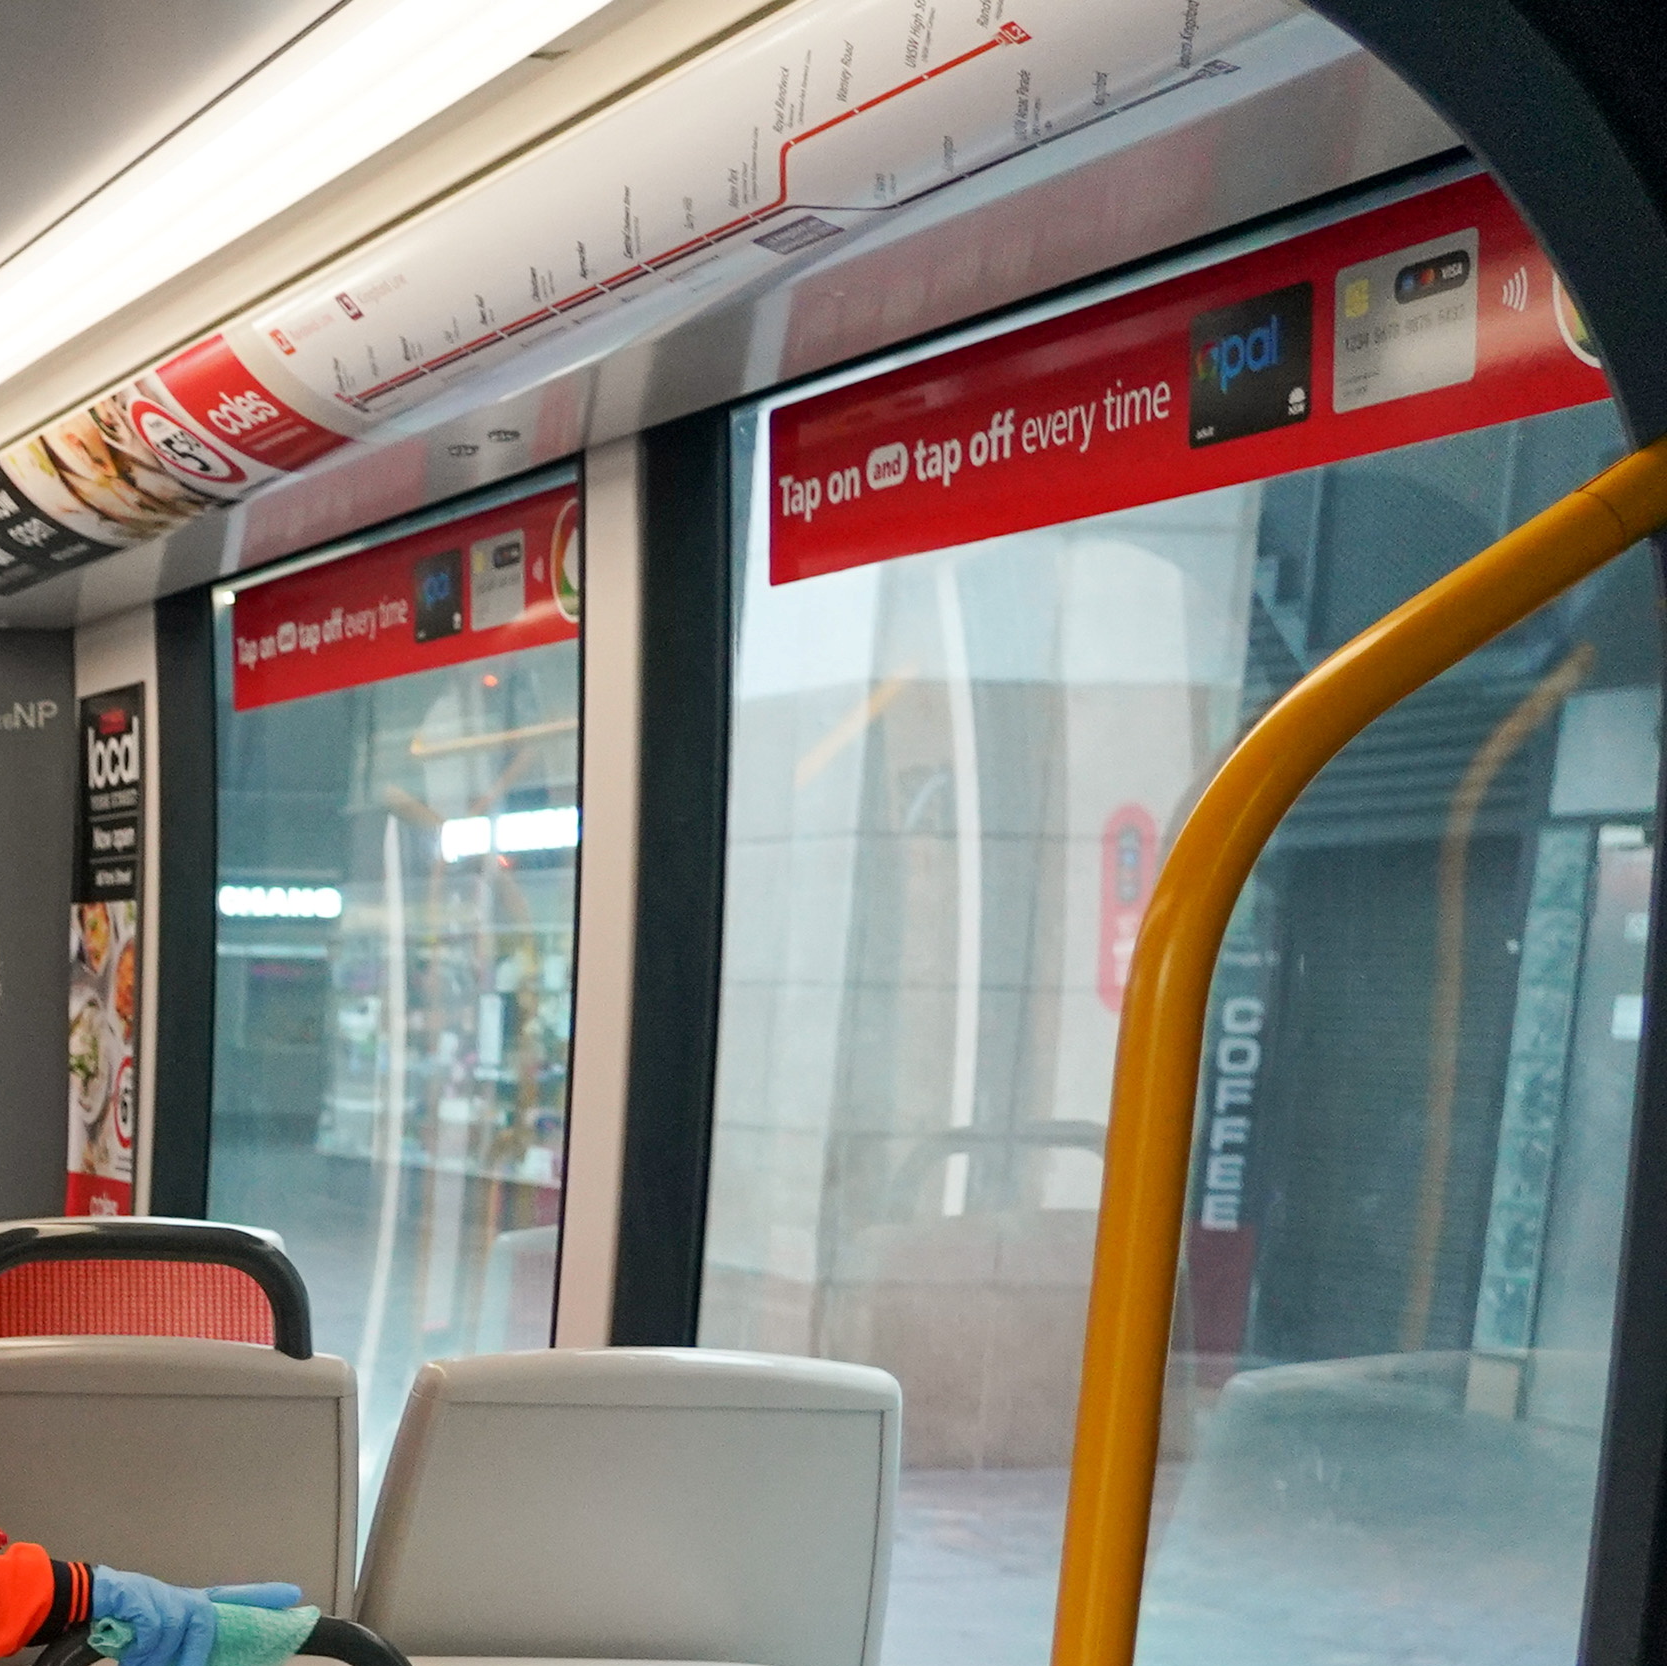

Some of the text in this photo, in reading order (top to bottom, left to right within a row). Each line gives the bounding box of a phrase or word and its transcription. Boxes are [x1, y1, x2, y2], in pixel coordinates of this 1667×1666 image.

[909, 12, 926, 39] High
[976, 0, 992, 28] Rand
[841, 40, 854, 65] Road
[905, 35, 920, 69] UNSW
[776, 66, 790, 111] Randwick
[1197, 313, 1282, 395] opal
[206, 389, 280, 436] coles
[779, 379, 1172, 523] Tap on and tap off every time
[1200, 996, 1265, 1233] COFFEE
